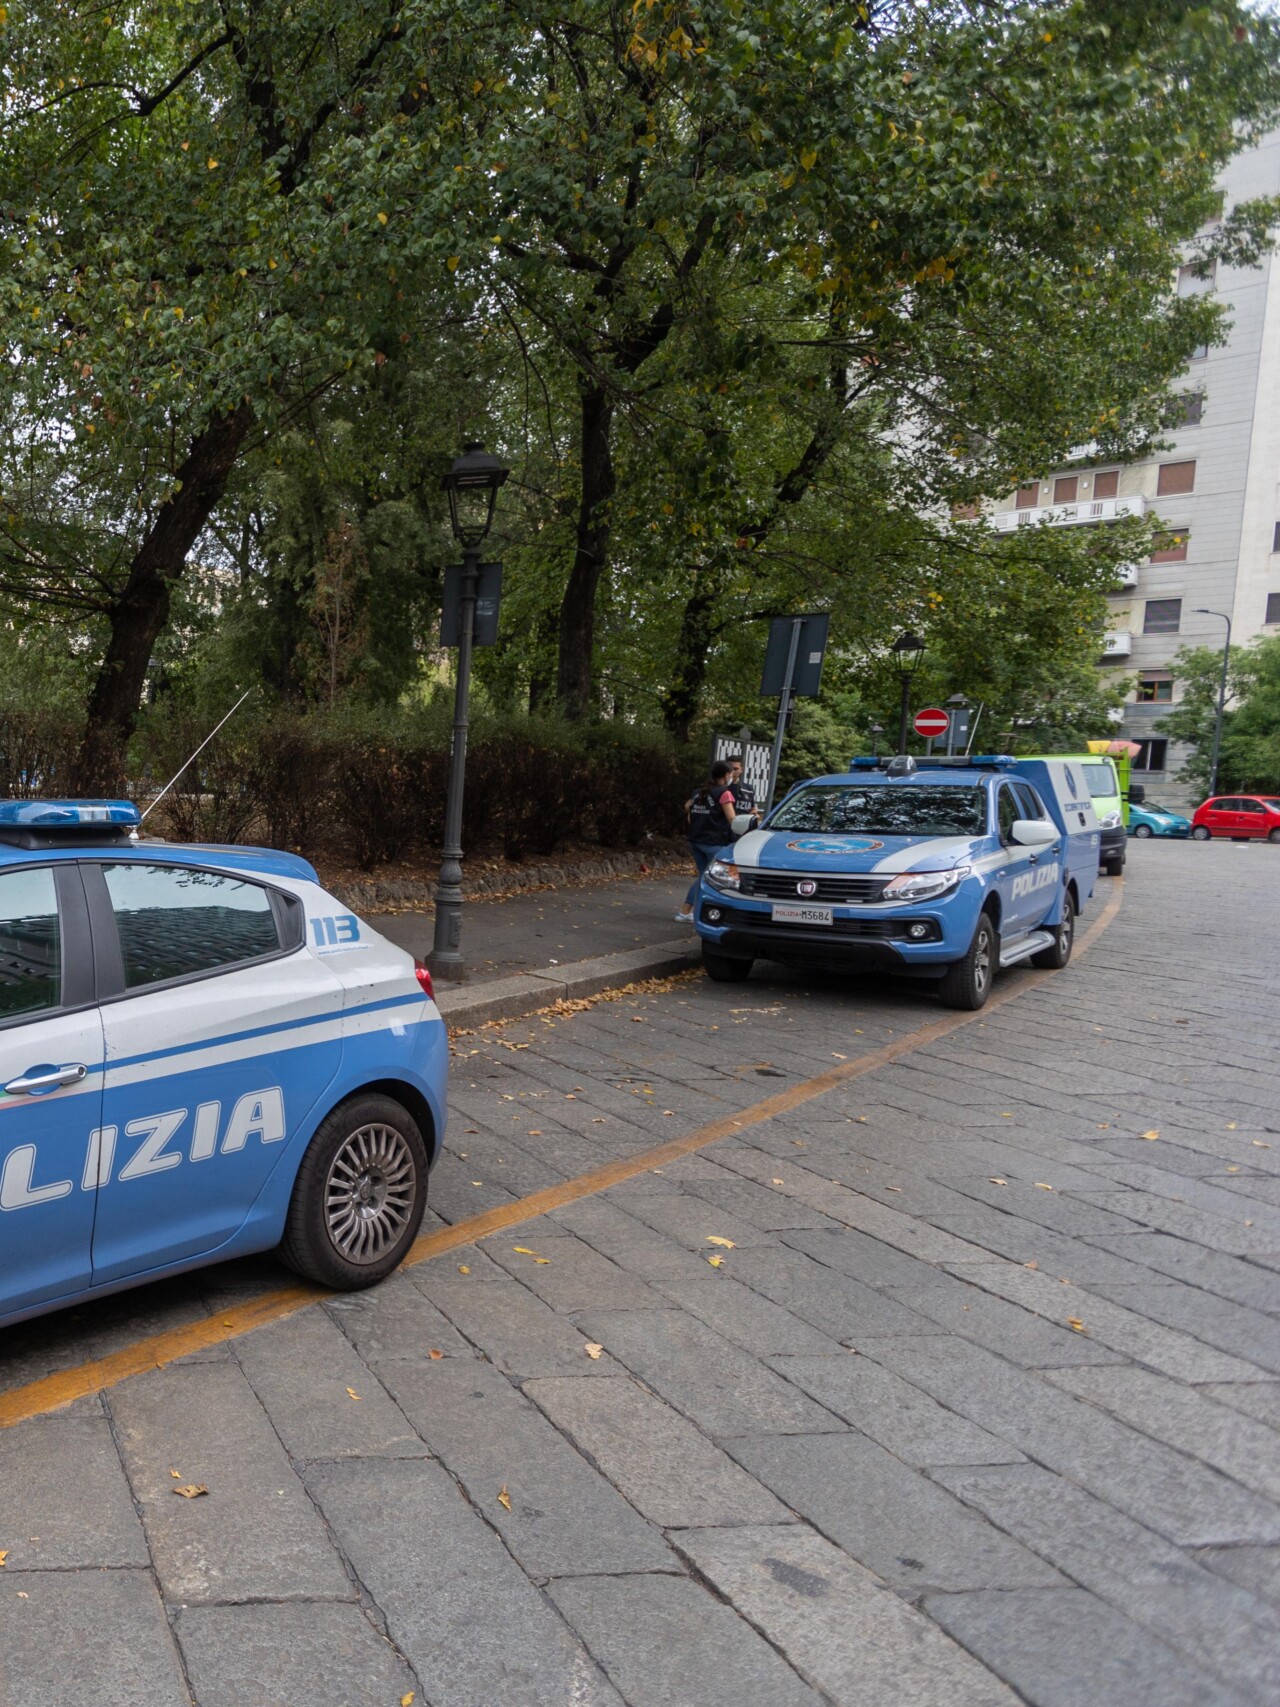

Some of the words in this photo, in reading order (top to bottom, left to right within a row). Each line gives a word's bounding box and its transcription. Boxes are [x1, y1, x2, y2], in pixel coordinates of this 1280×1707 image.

[1011, 862, 1059, 901] POLIZIA
[310, 915, 360, 947] 113
[775, 909, 799, 917] POLIZIA
[801, 910, 830, 921] M3684
